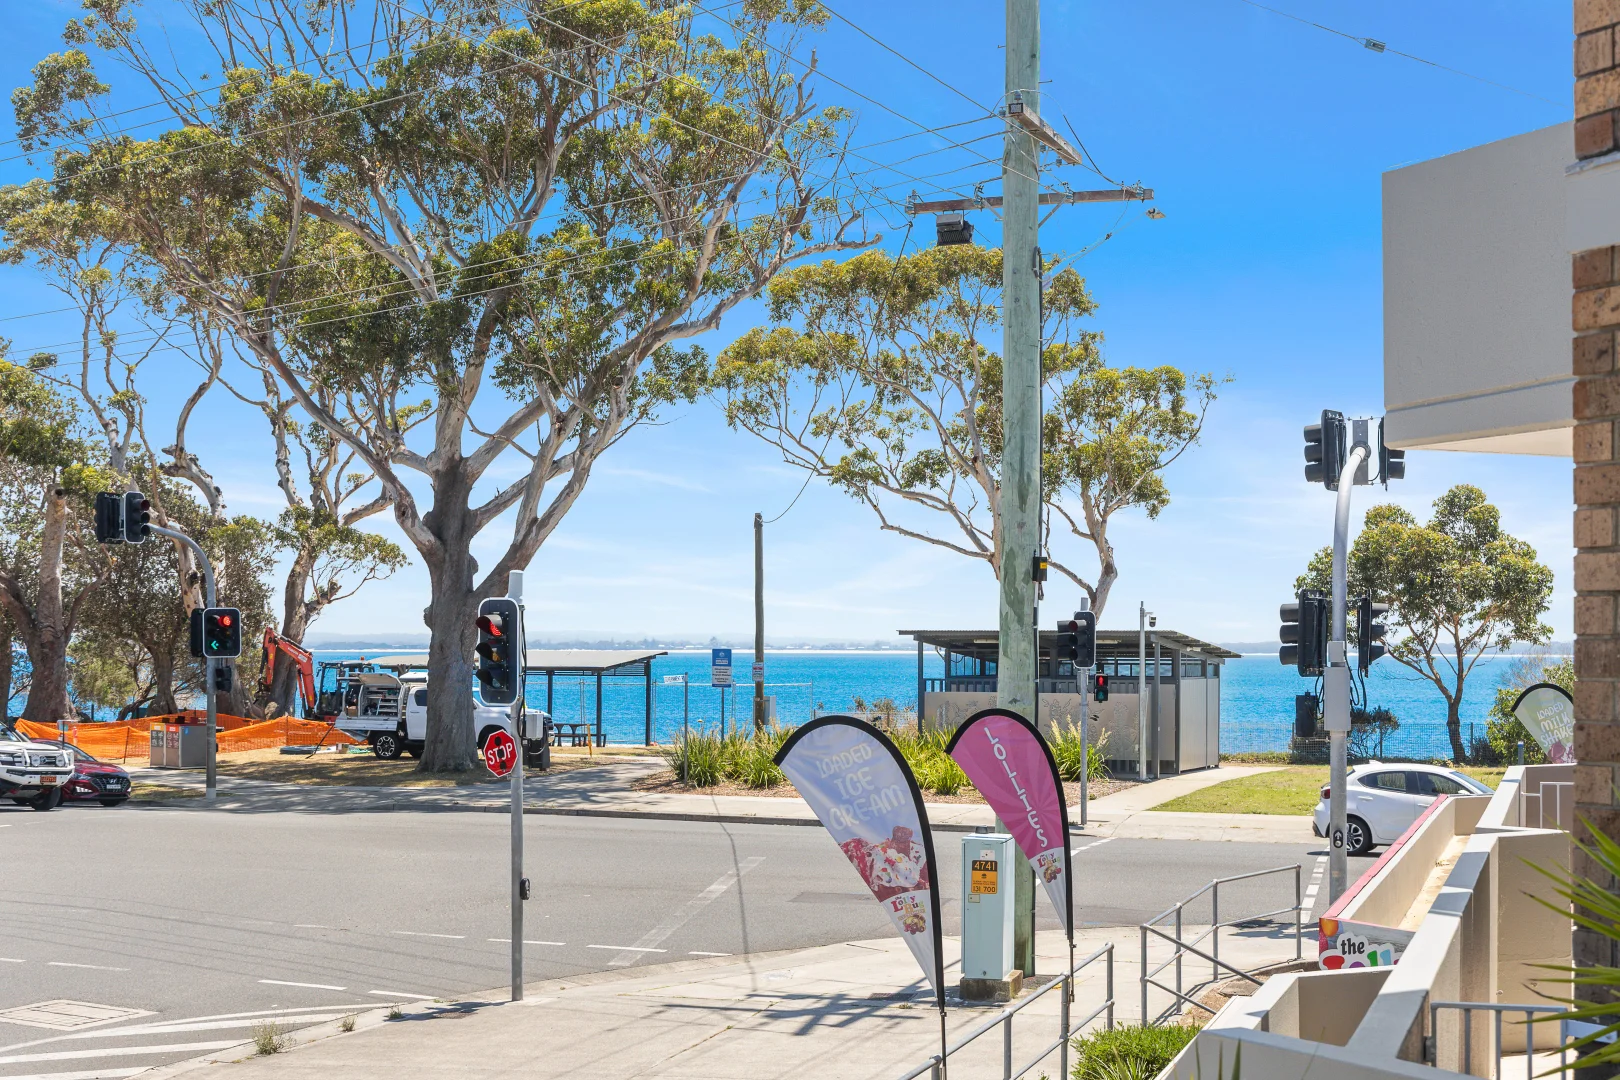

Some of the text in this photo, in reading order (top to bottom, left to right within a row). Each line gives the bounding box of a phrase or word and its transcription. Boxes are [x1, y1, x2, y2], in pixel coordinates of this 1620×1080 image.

[1537, 702, 1564, 720] LOADED
[1540, 711, 1570, 733] MILK
[487, 742, 513, 765] STOP
[816, 743, 872, 778] LOADED
[833, 766, 875, 800] ICE
[984, 727, 1048, 848] LOLLIES
[829, 784, 906, 830] CREAM
[974, 861, 995, 871] 4741
[1340, 938, 1366, 956] the
